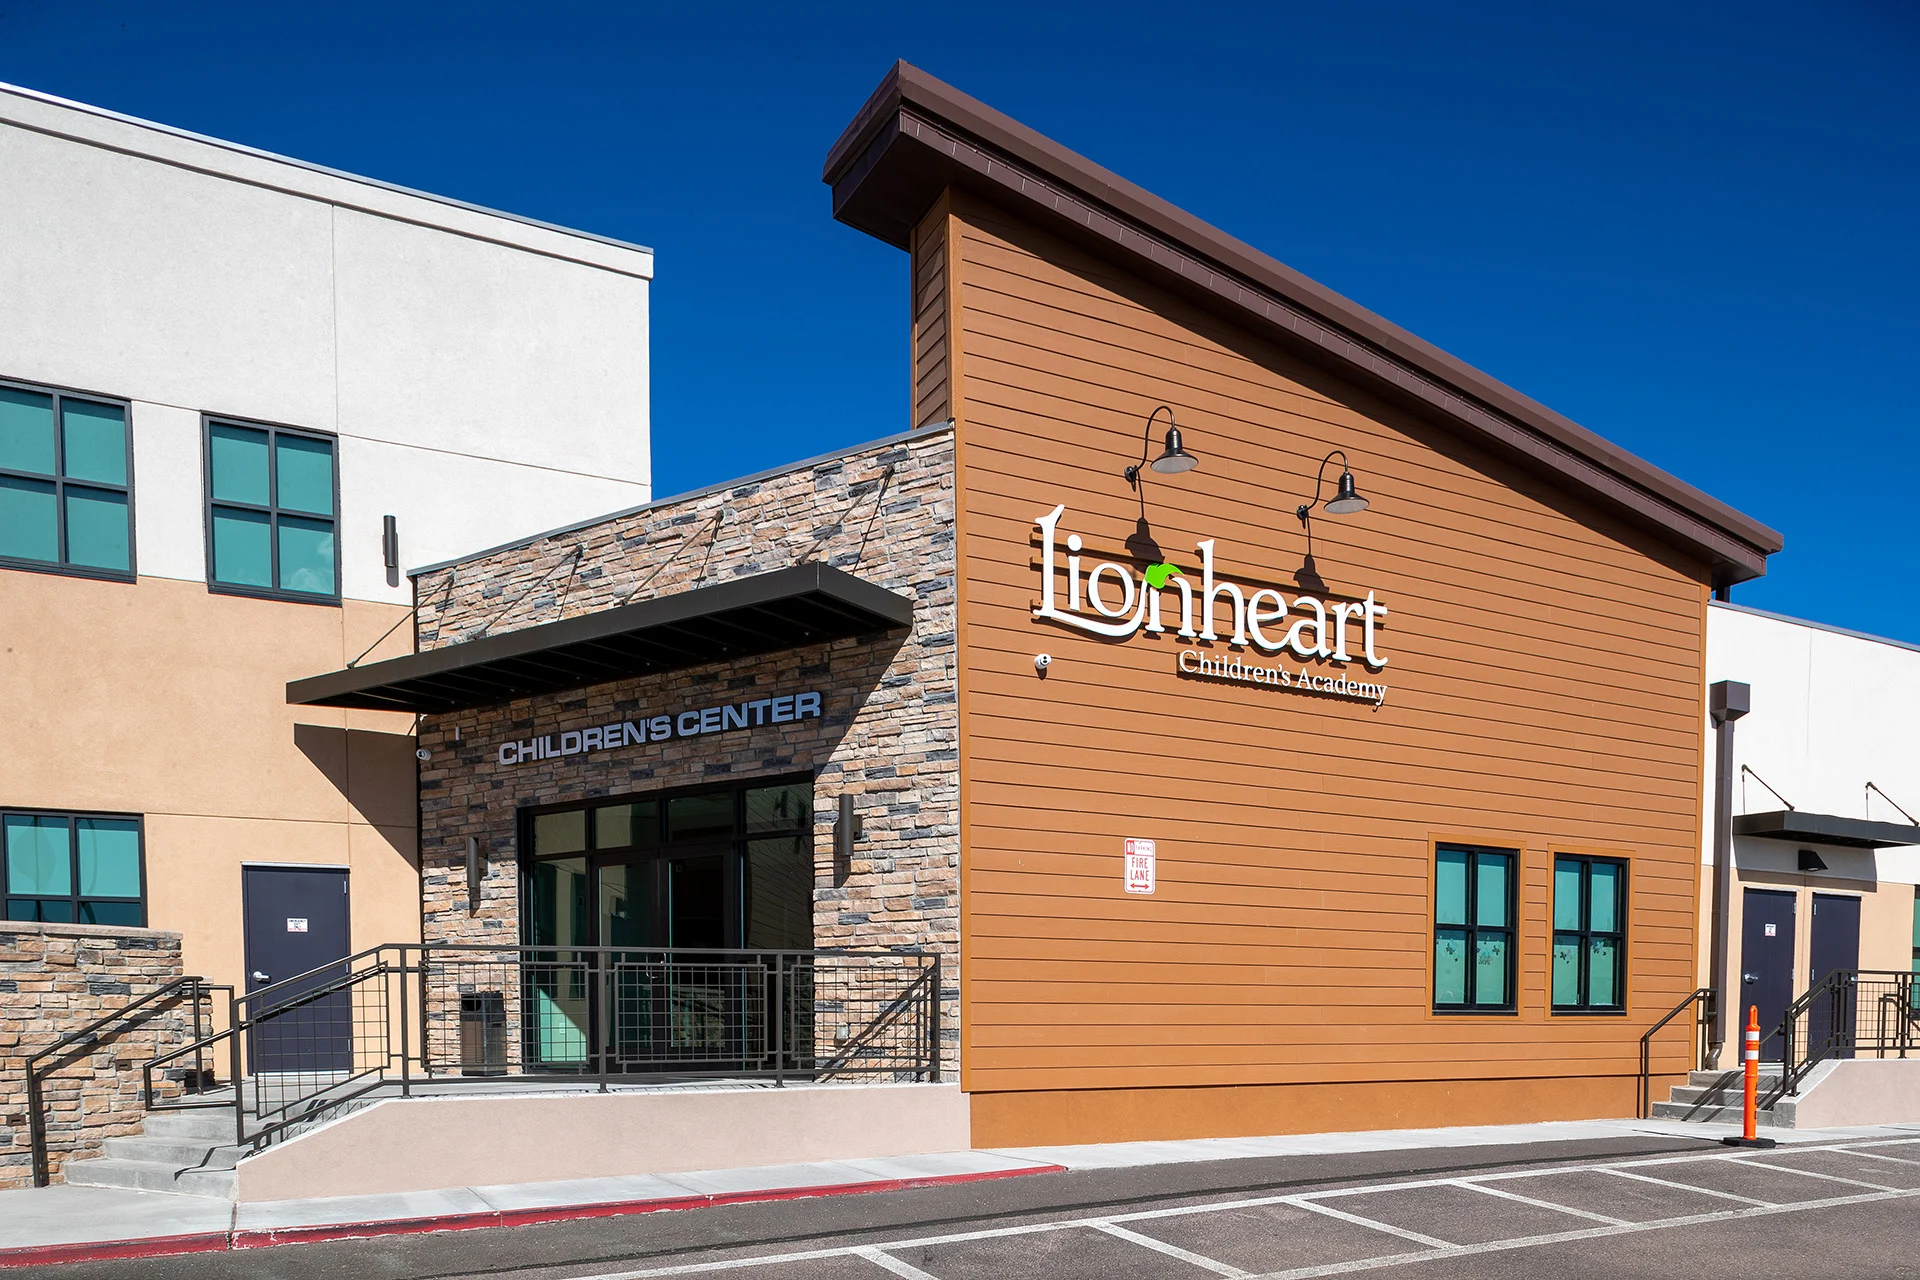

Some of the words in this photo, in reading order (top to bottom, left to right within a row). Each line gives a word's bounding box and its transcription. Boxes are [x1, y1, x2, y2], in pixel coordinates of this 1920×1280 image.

[1033, 504, 1388, 667] Lionheart
[1297, 671, 1388, 705] Academy
[499, 715, 672, 765] CHILDREN'S
[677, 691, 821, 736] CENTER
[1130, 869, 1149, 881] LANE
[1132, 857, 1148, 869] FIRE
